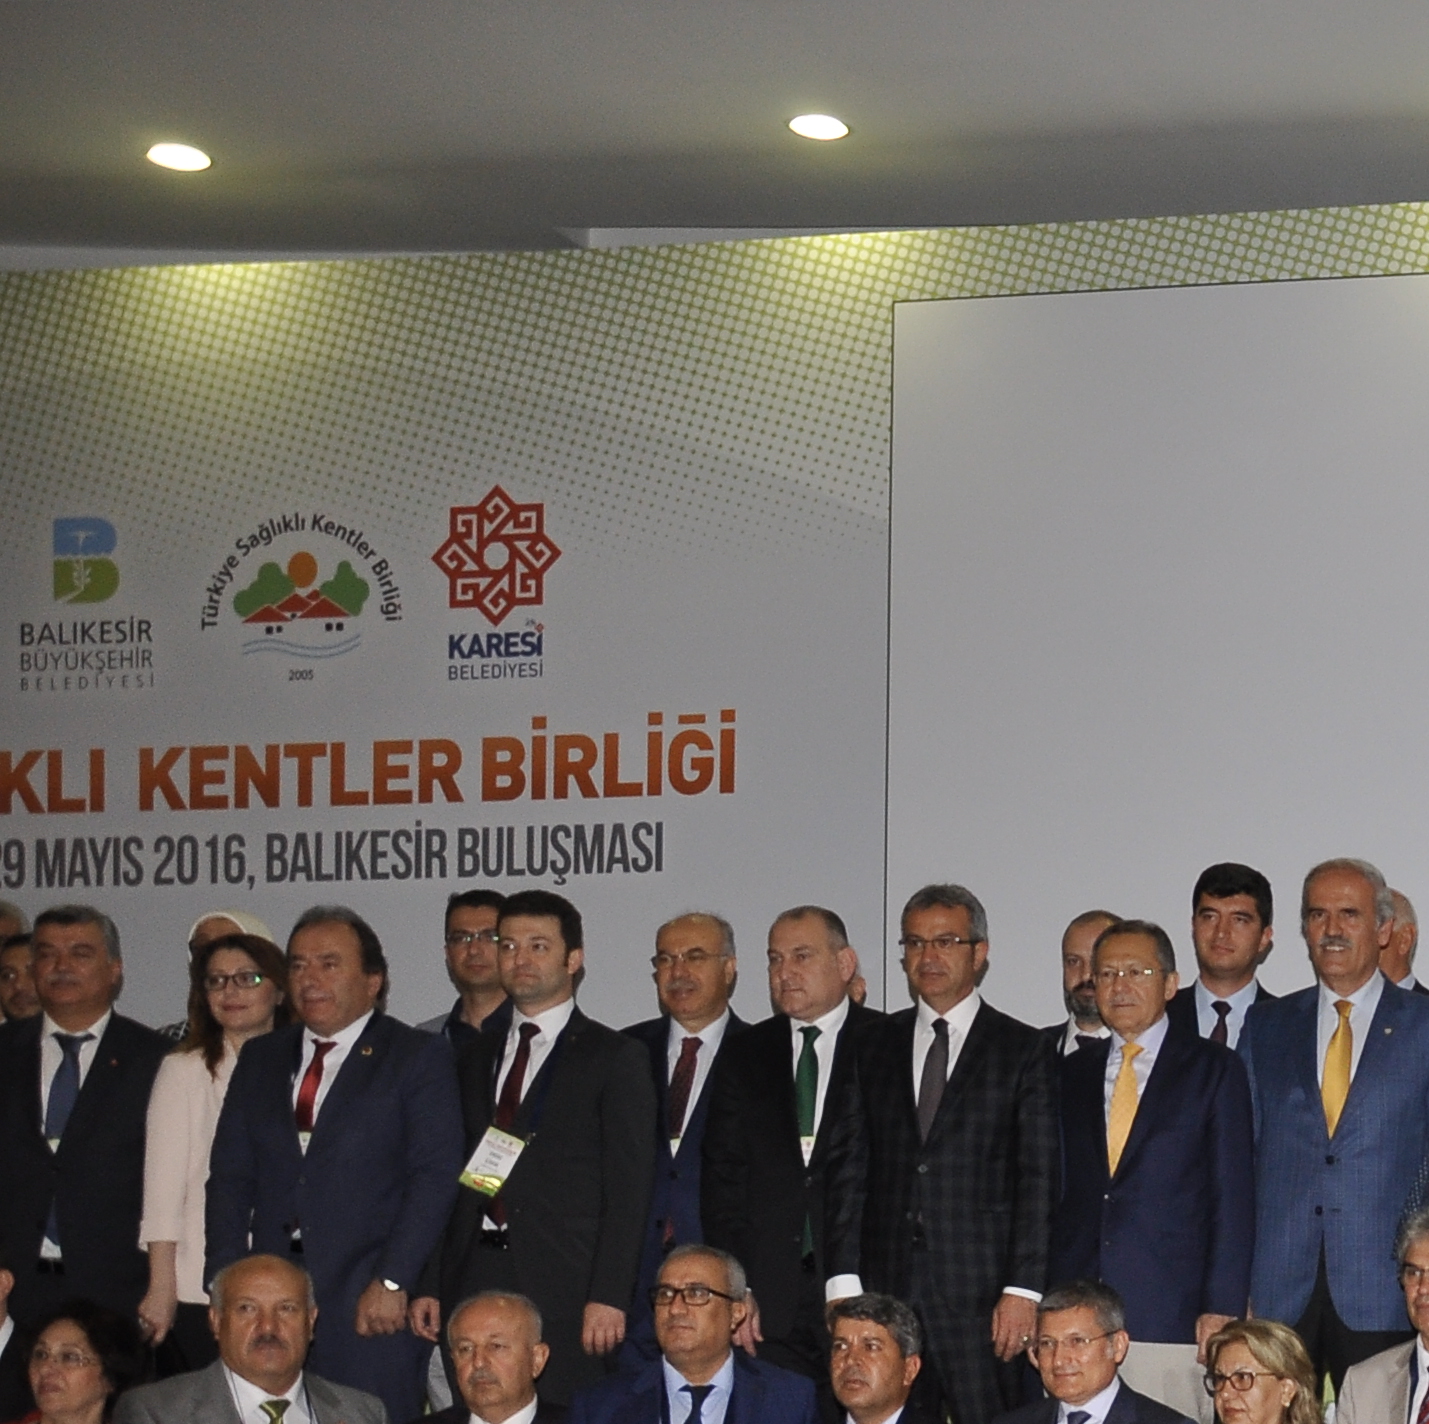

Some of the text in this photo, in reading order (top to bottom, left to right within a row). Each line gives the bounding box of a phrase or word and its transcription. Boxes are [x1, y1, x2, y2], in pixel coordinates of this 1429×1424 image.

[201, 512, 402, 631] Türkiye Sağlıklı Kentler Birliği
[20, 616, 153, 646] BALIKESİR
[20, 646, 153, 675] BÜYÜKŞEHİR
[288, 669, 314, 681] 2005
[448, 659, 543, 680] BELEDİYESİ
[20, 674, 155, 691] BELEDİYESİ
[139, 738, 464, 811] KENTLER
[481, 709, 736, 801] BİRLİĞİ
[0, 820, 663, 889] 9 MAYIS 2016, BALIKESİR BULUŞMASI
